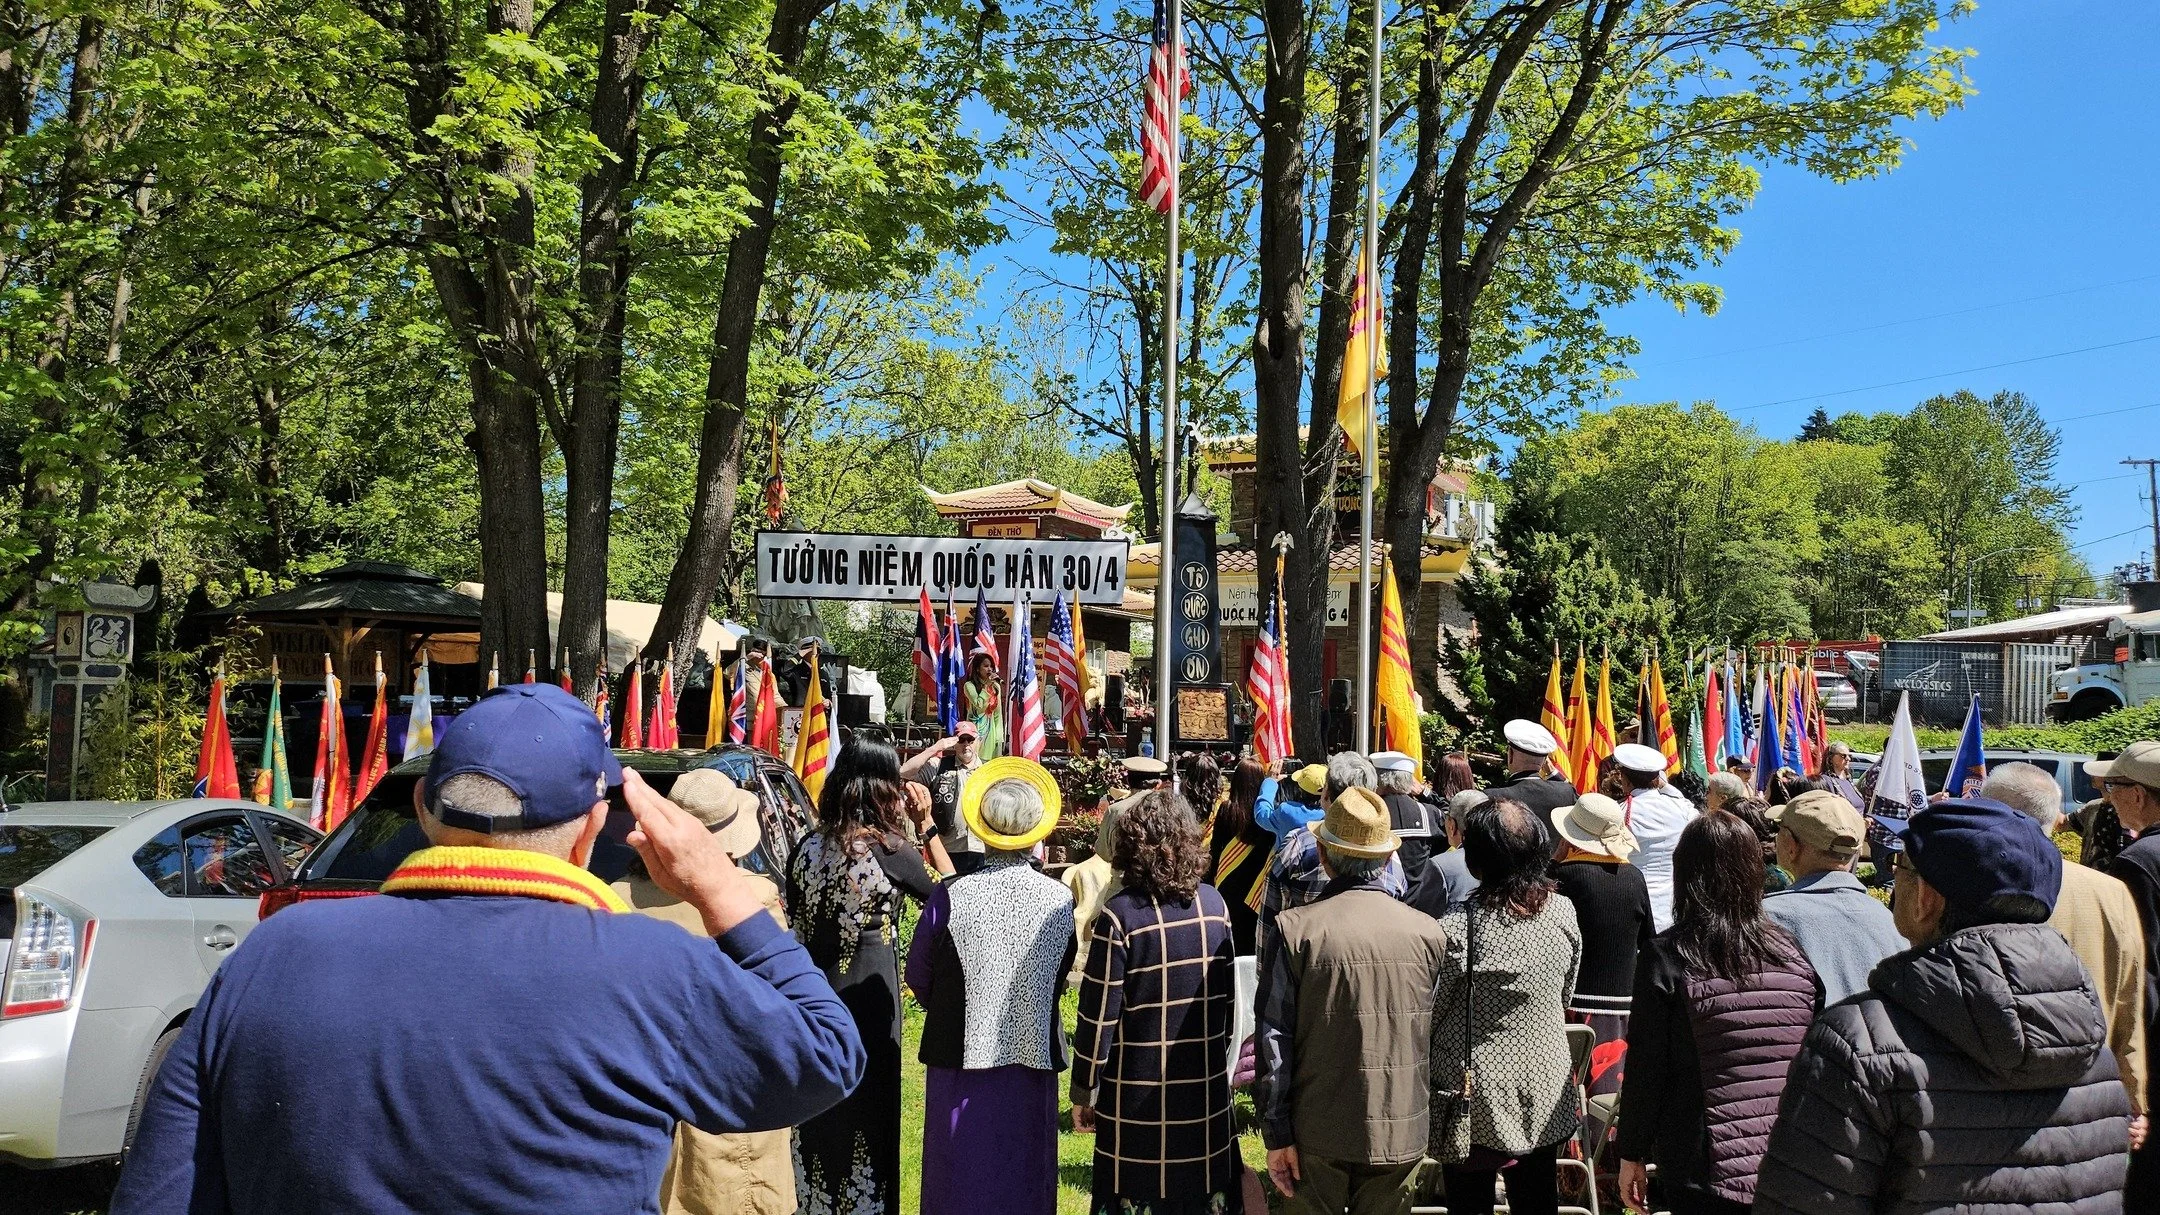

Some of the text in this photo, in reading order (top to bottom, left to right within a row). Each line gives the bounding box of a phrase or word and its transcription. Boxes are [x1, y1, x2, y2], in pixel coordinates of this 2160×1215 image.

[768, 539, 849, 585] TƯỞNG
[932, 542, 996, 593] QUỐC
[1004, 547, 1054, 601] HẬN
[1063, 554, 1119, 595] 30/4
[1184, 595, 1206, 619] QUỐC
[1340, 608, 1348, 622] 4
[1185, 626, 1206, 649] GHI
[1812, 649, 1840, 659] ublic
[1187, 655, 1205, 679] ƠN
